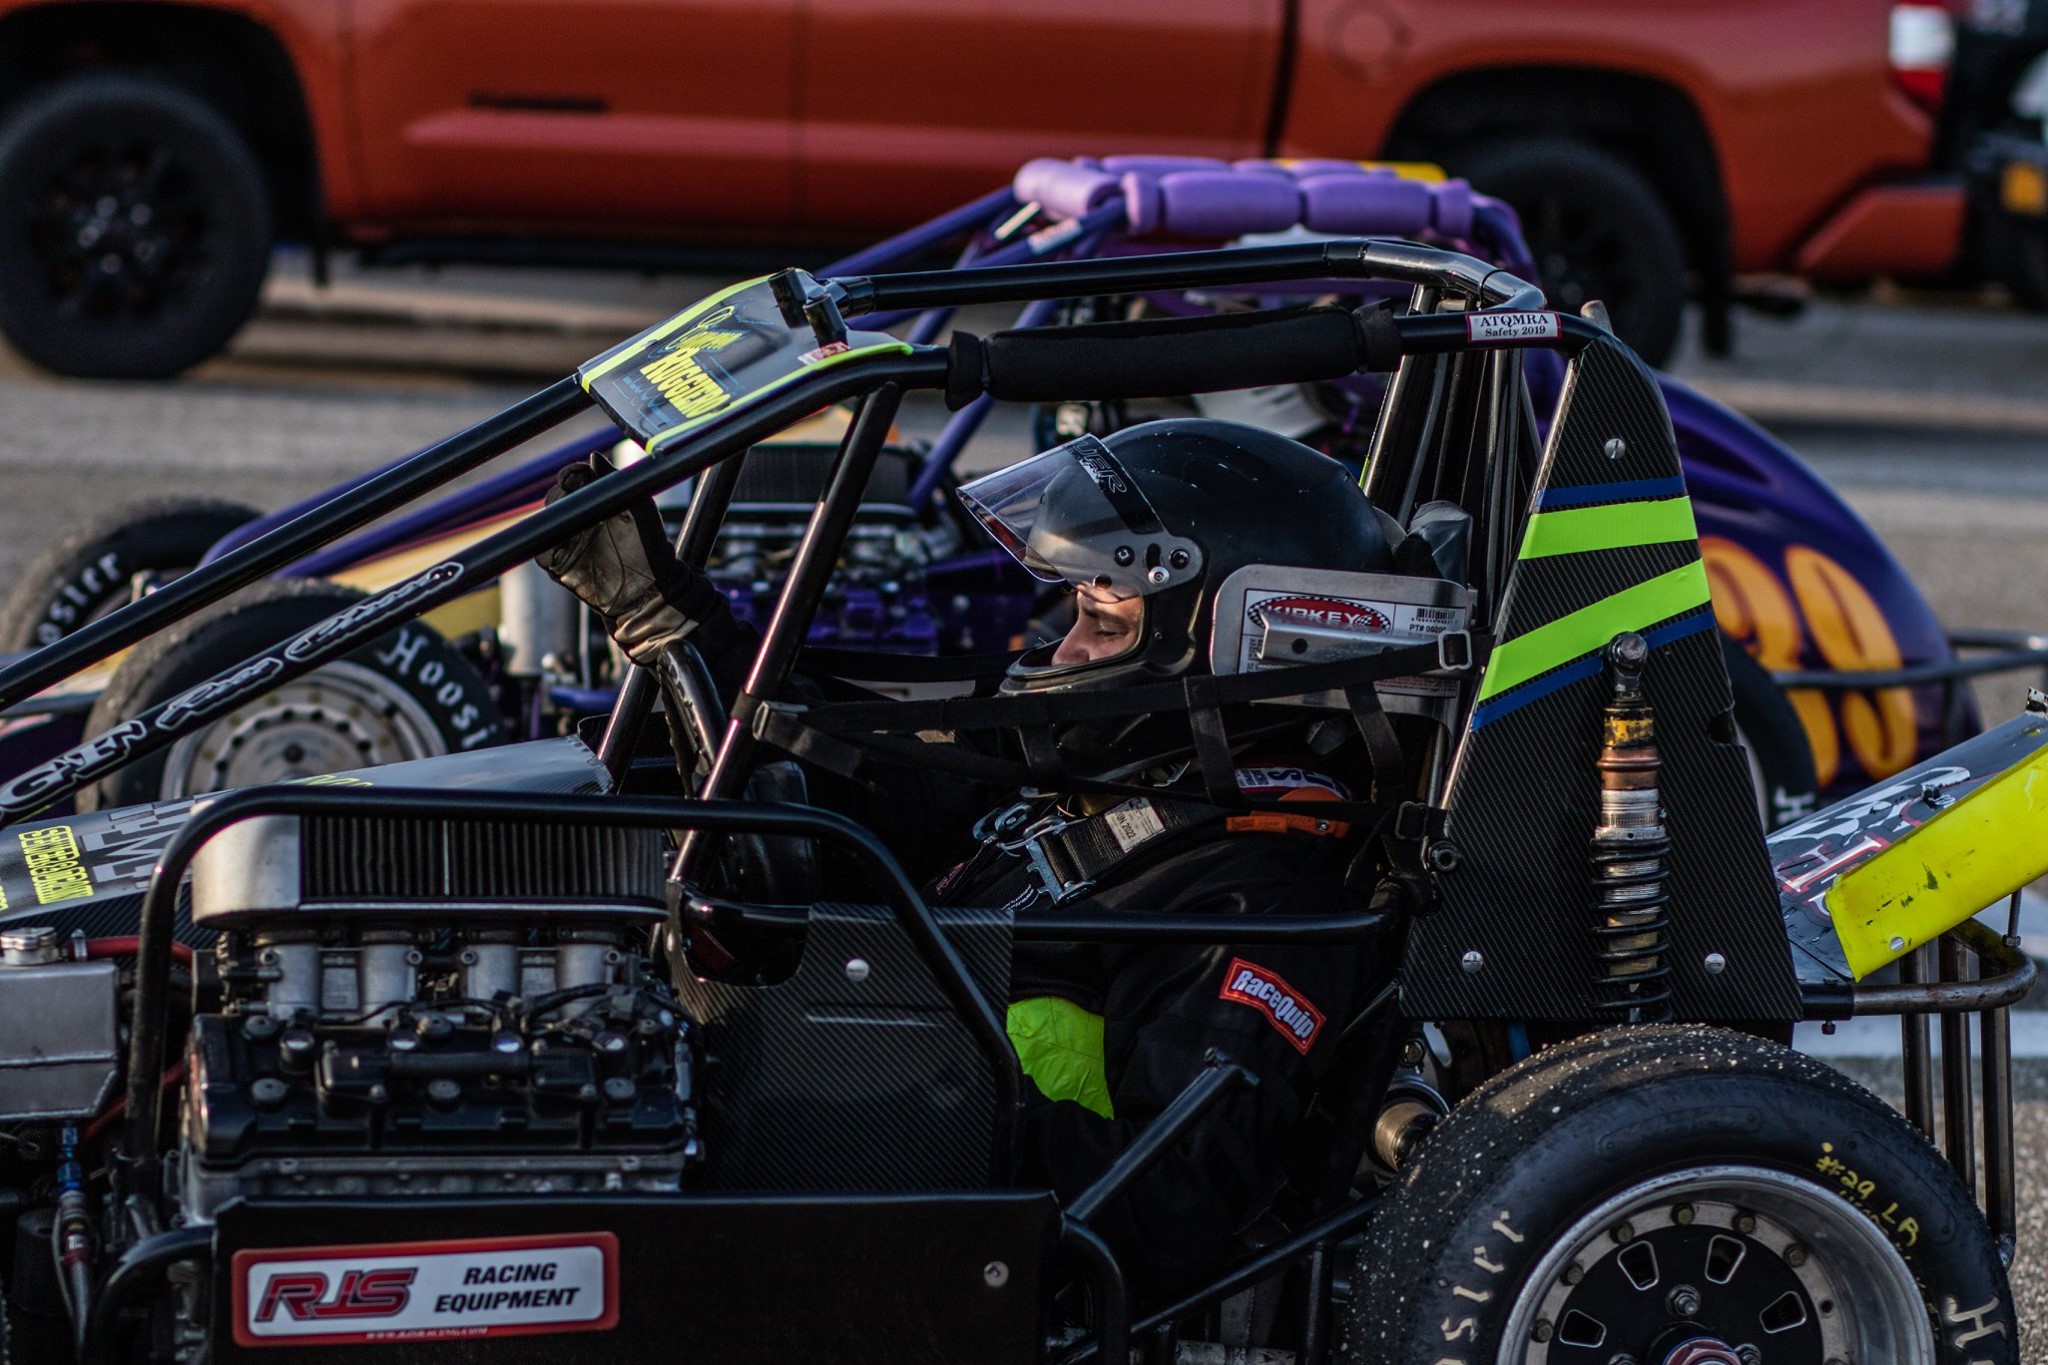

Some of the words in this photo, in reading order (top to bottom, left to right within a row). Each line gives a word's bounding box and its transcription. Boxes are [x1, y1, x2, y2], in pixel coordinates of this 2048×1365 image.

[1480, 314, 1548, 327] ATQMRA
[1485, 327, 1518, 337] Safety
[1521, 325, 1546, 335] 2019
[640, 347, 731, 418] RUGGIERO
[1231, 970, 1315, 1038] RaceQuip
[254, 1267, 418, 1322] RJS
[463, 1263, 557, 1285] RACING
[434, 1287, 580, 1314] EQUIPMENT
